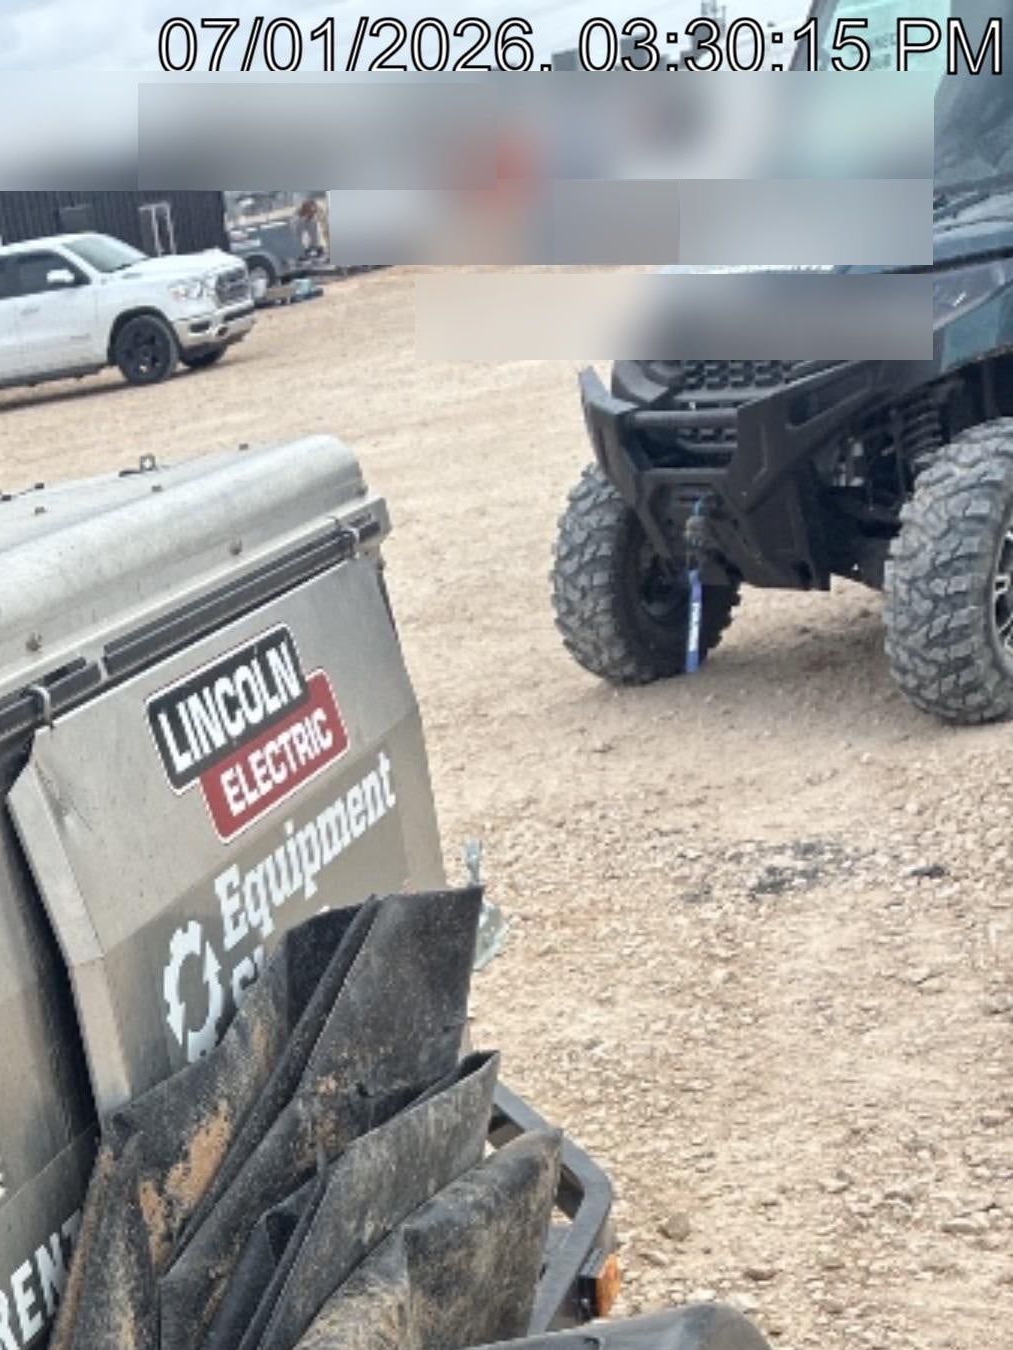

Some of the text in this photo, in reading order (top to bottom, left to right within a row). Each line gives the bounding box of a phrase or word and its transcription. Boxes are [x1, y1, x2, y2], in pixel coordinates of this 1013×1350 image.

[158, 641, 303, 774] LINCOLN
[220, 707, 334, 817] ELECTRIC
[214, 751, 398, 953] Equipment
